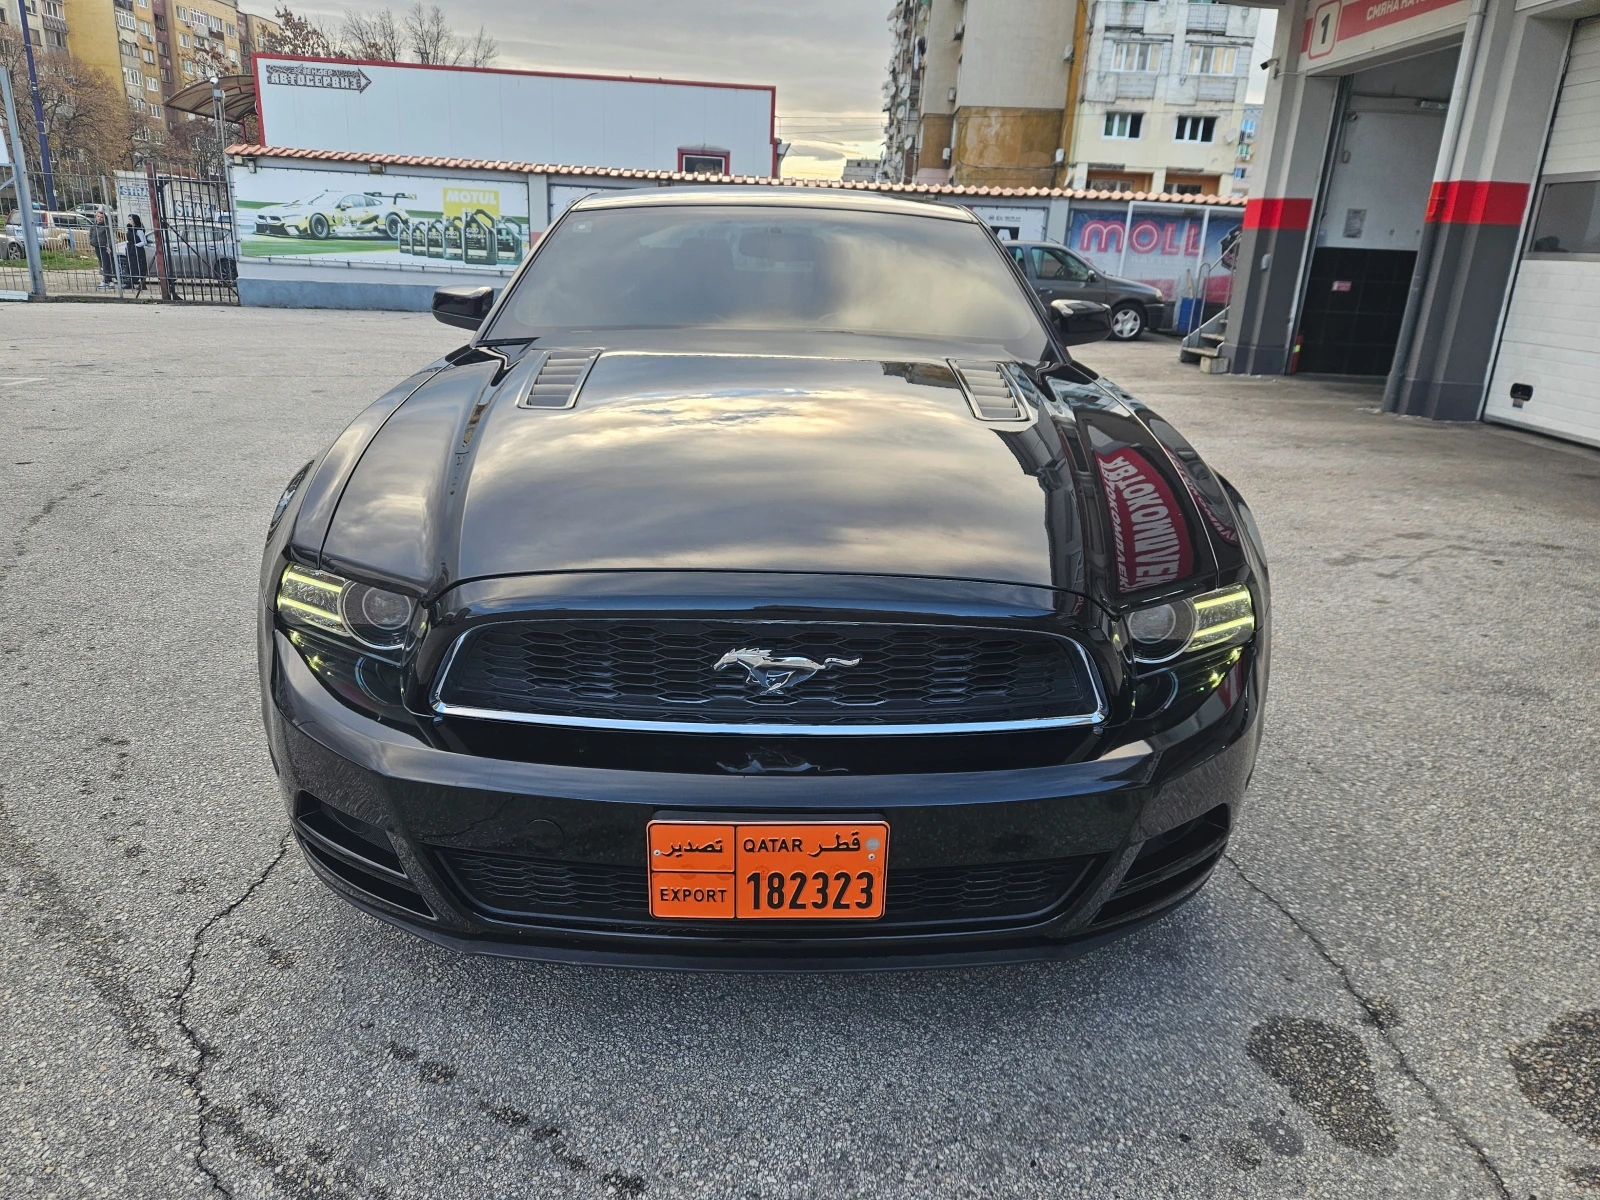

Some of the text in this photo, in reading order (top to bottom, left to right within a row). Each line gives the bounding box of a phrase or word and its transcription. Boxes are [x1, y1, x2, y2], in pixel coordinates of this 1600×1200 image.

[1366, 0, 1399, 21] СМЯНА
[1321, 13, 1331, 45] 1
[270, 72, 358, 89] АВТОСЕРВИЗ
[446, 189, 497, 205] MOTUL
[1079, 219, 1206, 257] MOLL
[661, 838, 724, 859] تصدير
[743, 837, 804, 853] QATAR
[807, 831, 861, 858] قطر
[660, 888, 727, 903] EXPORT
[746, 871, 874, 910] 182323
